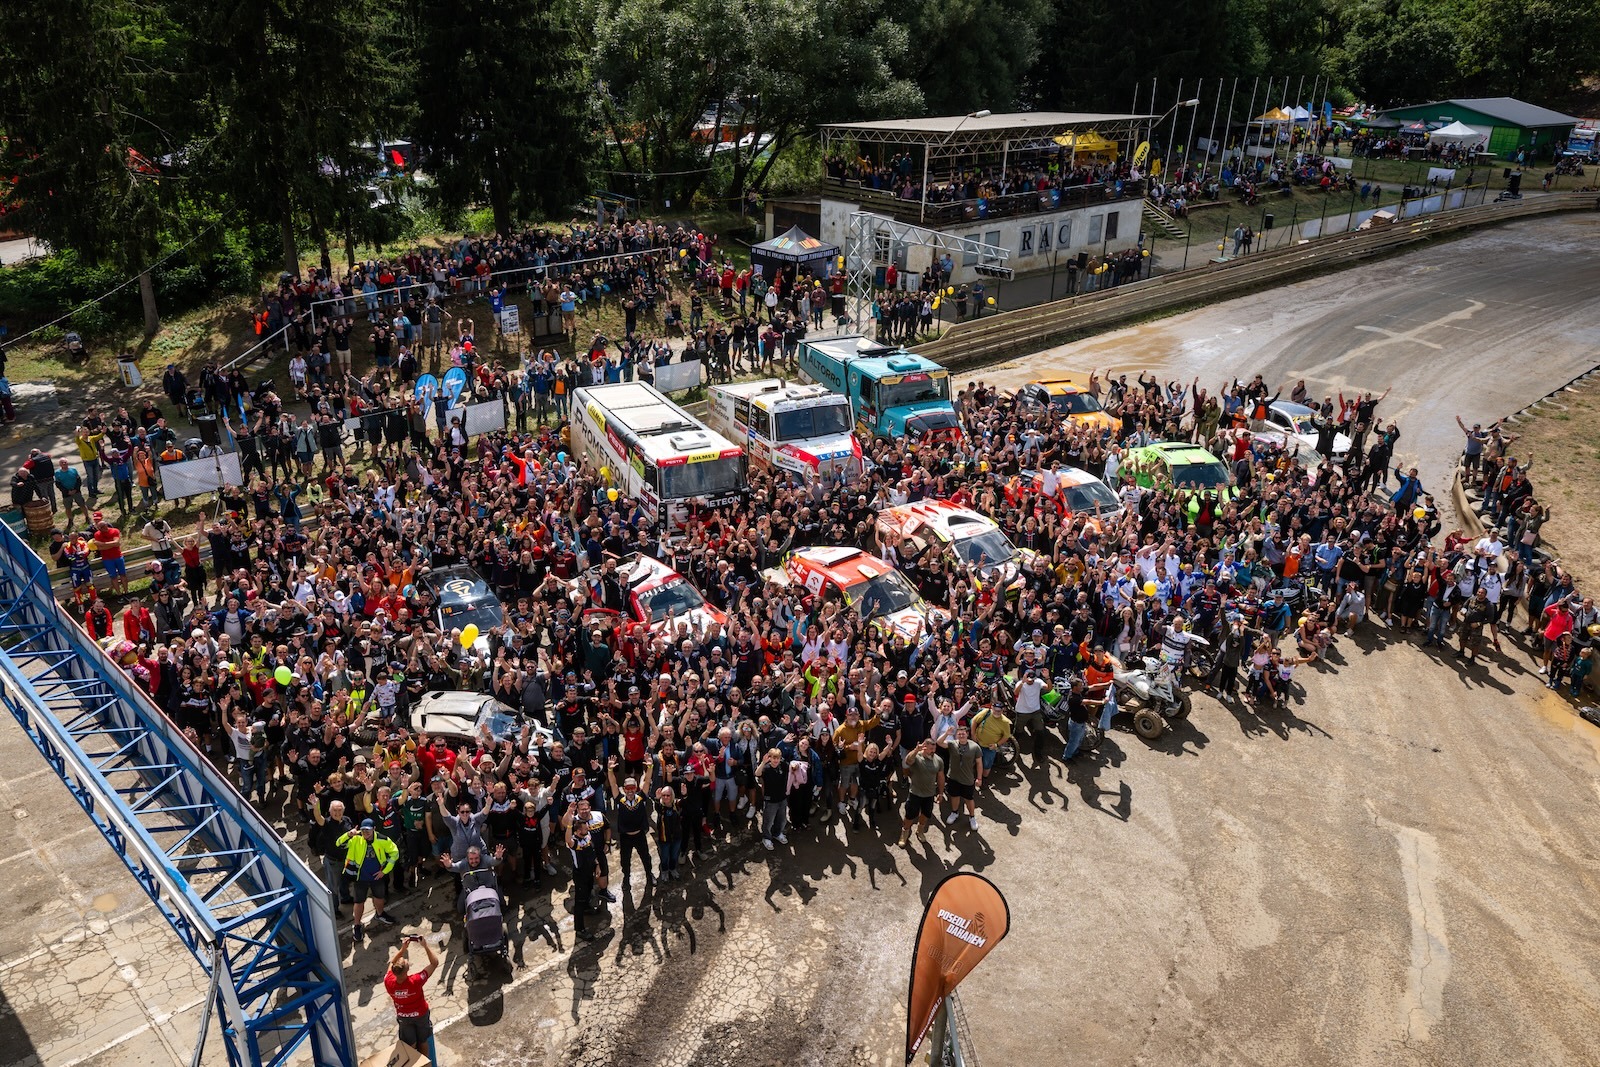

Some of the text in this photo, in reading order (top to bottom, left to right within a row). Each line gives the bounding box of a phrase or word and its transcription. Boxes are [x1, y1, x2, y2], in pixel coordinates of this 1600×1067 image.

[590, 405, 604, 427] SILMET
[574, 407, 627, 489] PROMETEON
[692, 453, 717, 461] SILMET
[644, 579, 682, 598] HILUX
[937, 909, 971, 930] POSEDLÍ
